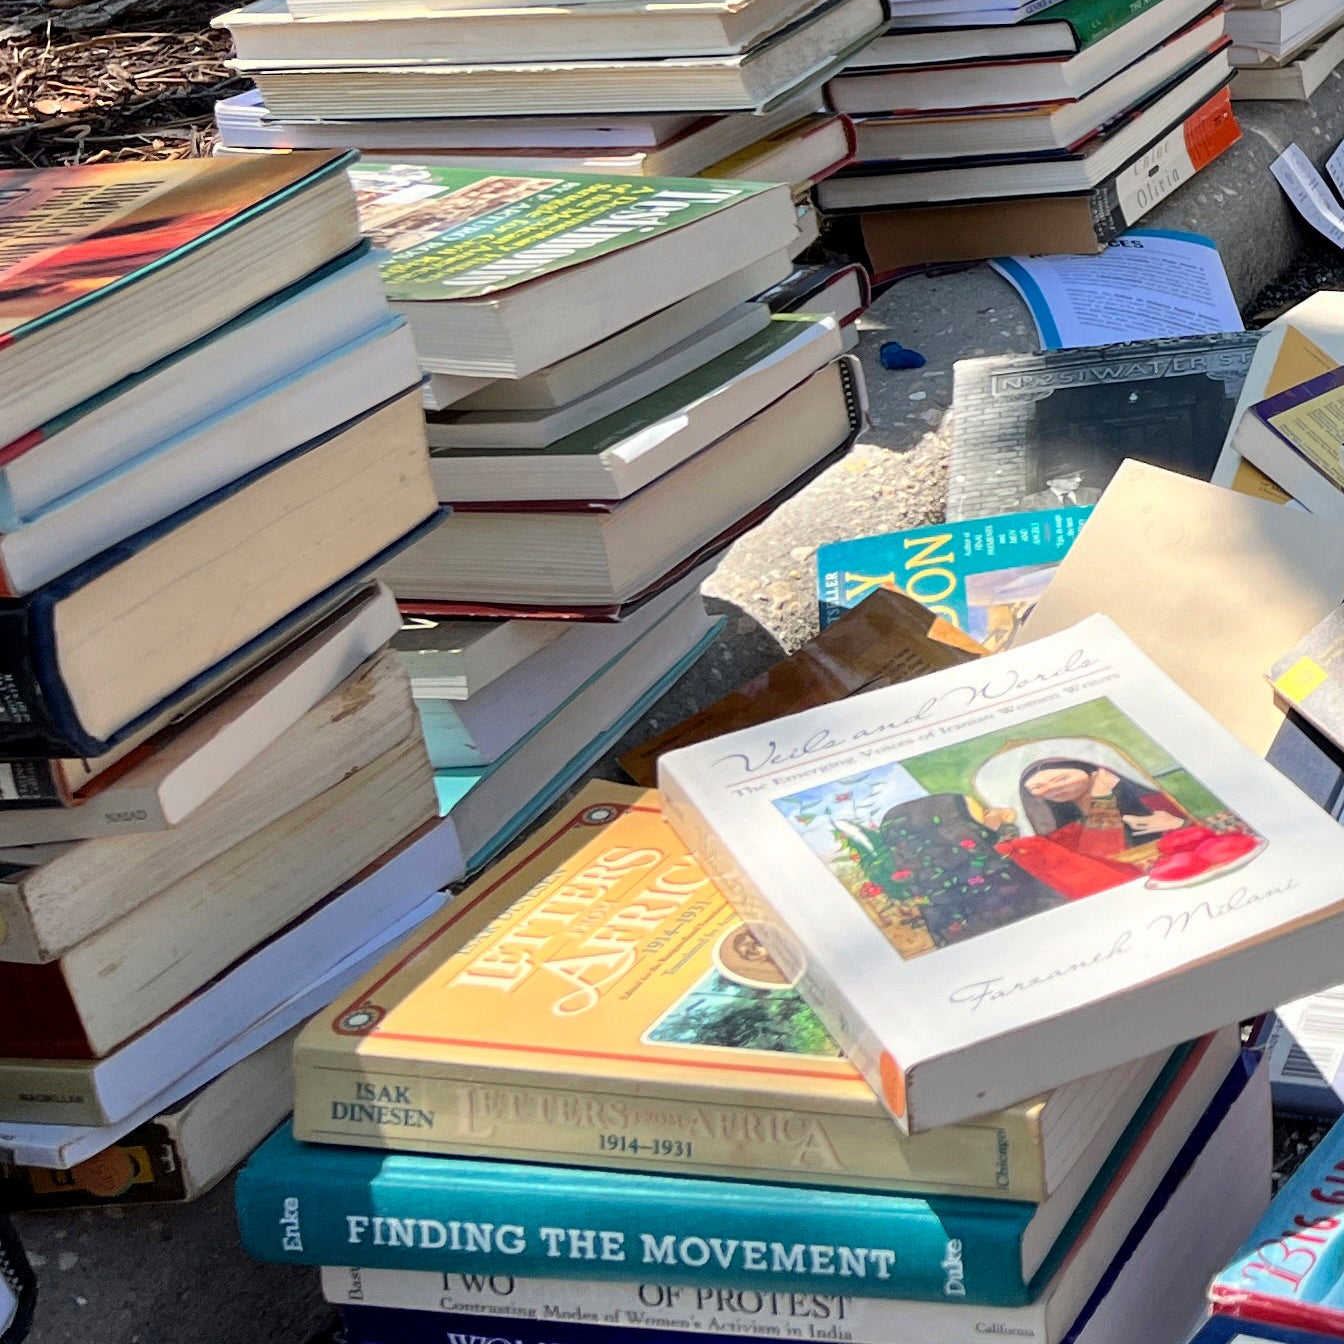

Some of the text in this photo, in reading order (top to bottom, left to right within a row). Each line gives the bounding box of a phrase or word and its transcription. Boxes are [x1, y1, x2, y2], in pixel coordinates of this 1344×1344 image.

[1136, 167, 1181, 210] Olivia
[1095, 353, 1208, 383] WATER
[713, 648, 1101, 774] Veils and Words
[733, 671, 1122, 798] The Emerging Voices of Iranian Women Writers
[451, 845, 665, 993] LETTERS
[544, 852, 710, 1017] AFRIC
[564, 900, 621, 940] FROM
[949, 876, 1302, 1012] Farzaneh Milani
[331, 1101, 434, 1130] DINESEN
[355, 1081, 411, 1106] ISAK
[452, 1082, 847, 1171] LETTERS FROM AFRICA
[280, 1196, 304, 1253] Enke
[345, 1214, 897, 1281] FINDING THE MOVEMENT
[1241, 1213, 1341, 1294] BIG
[940, 1236, 968, 1297] Duke
[440, 1296, 854, 1341] Contrasting Modes of Women's Activism in India
[637, 1282, 683, 1308] OF
[692, 1285, 852, 1321] PROTEST
[974, 1321, 1037, 1339] California
